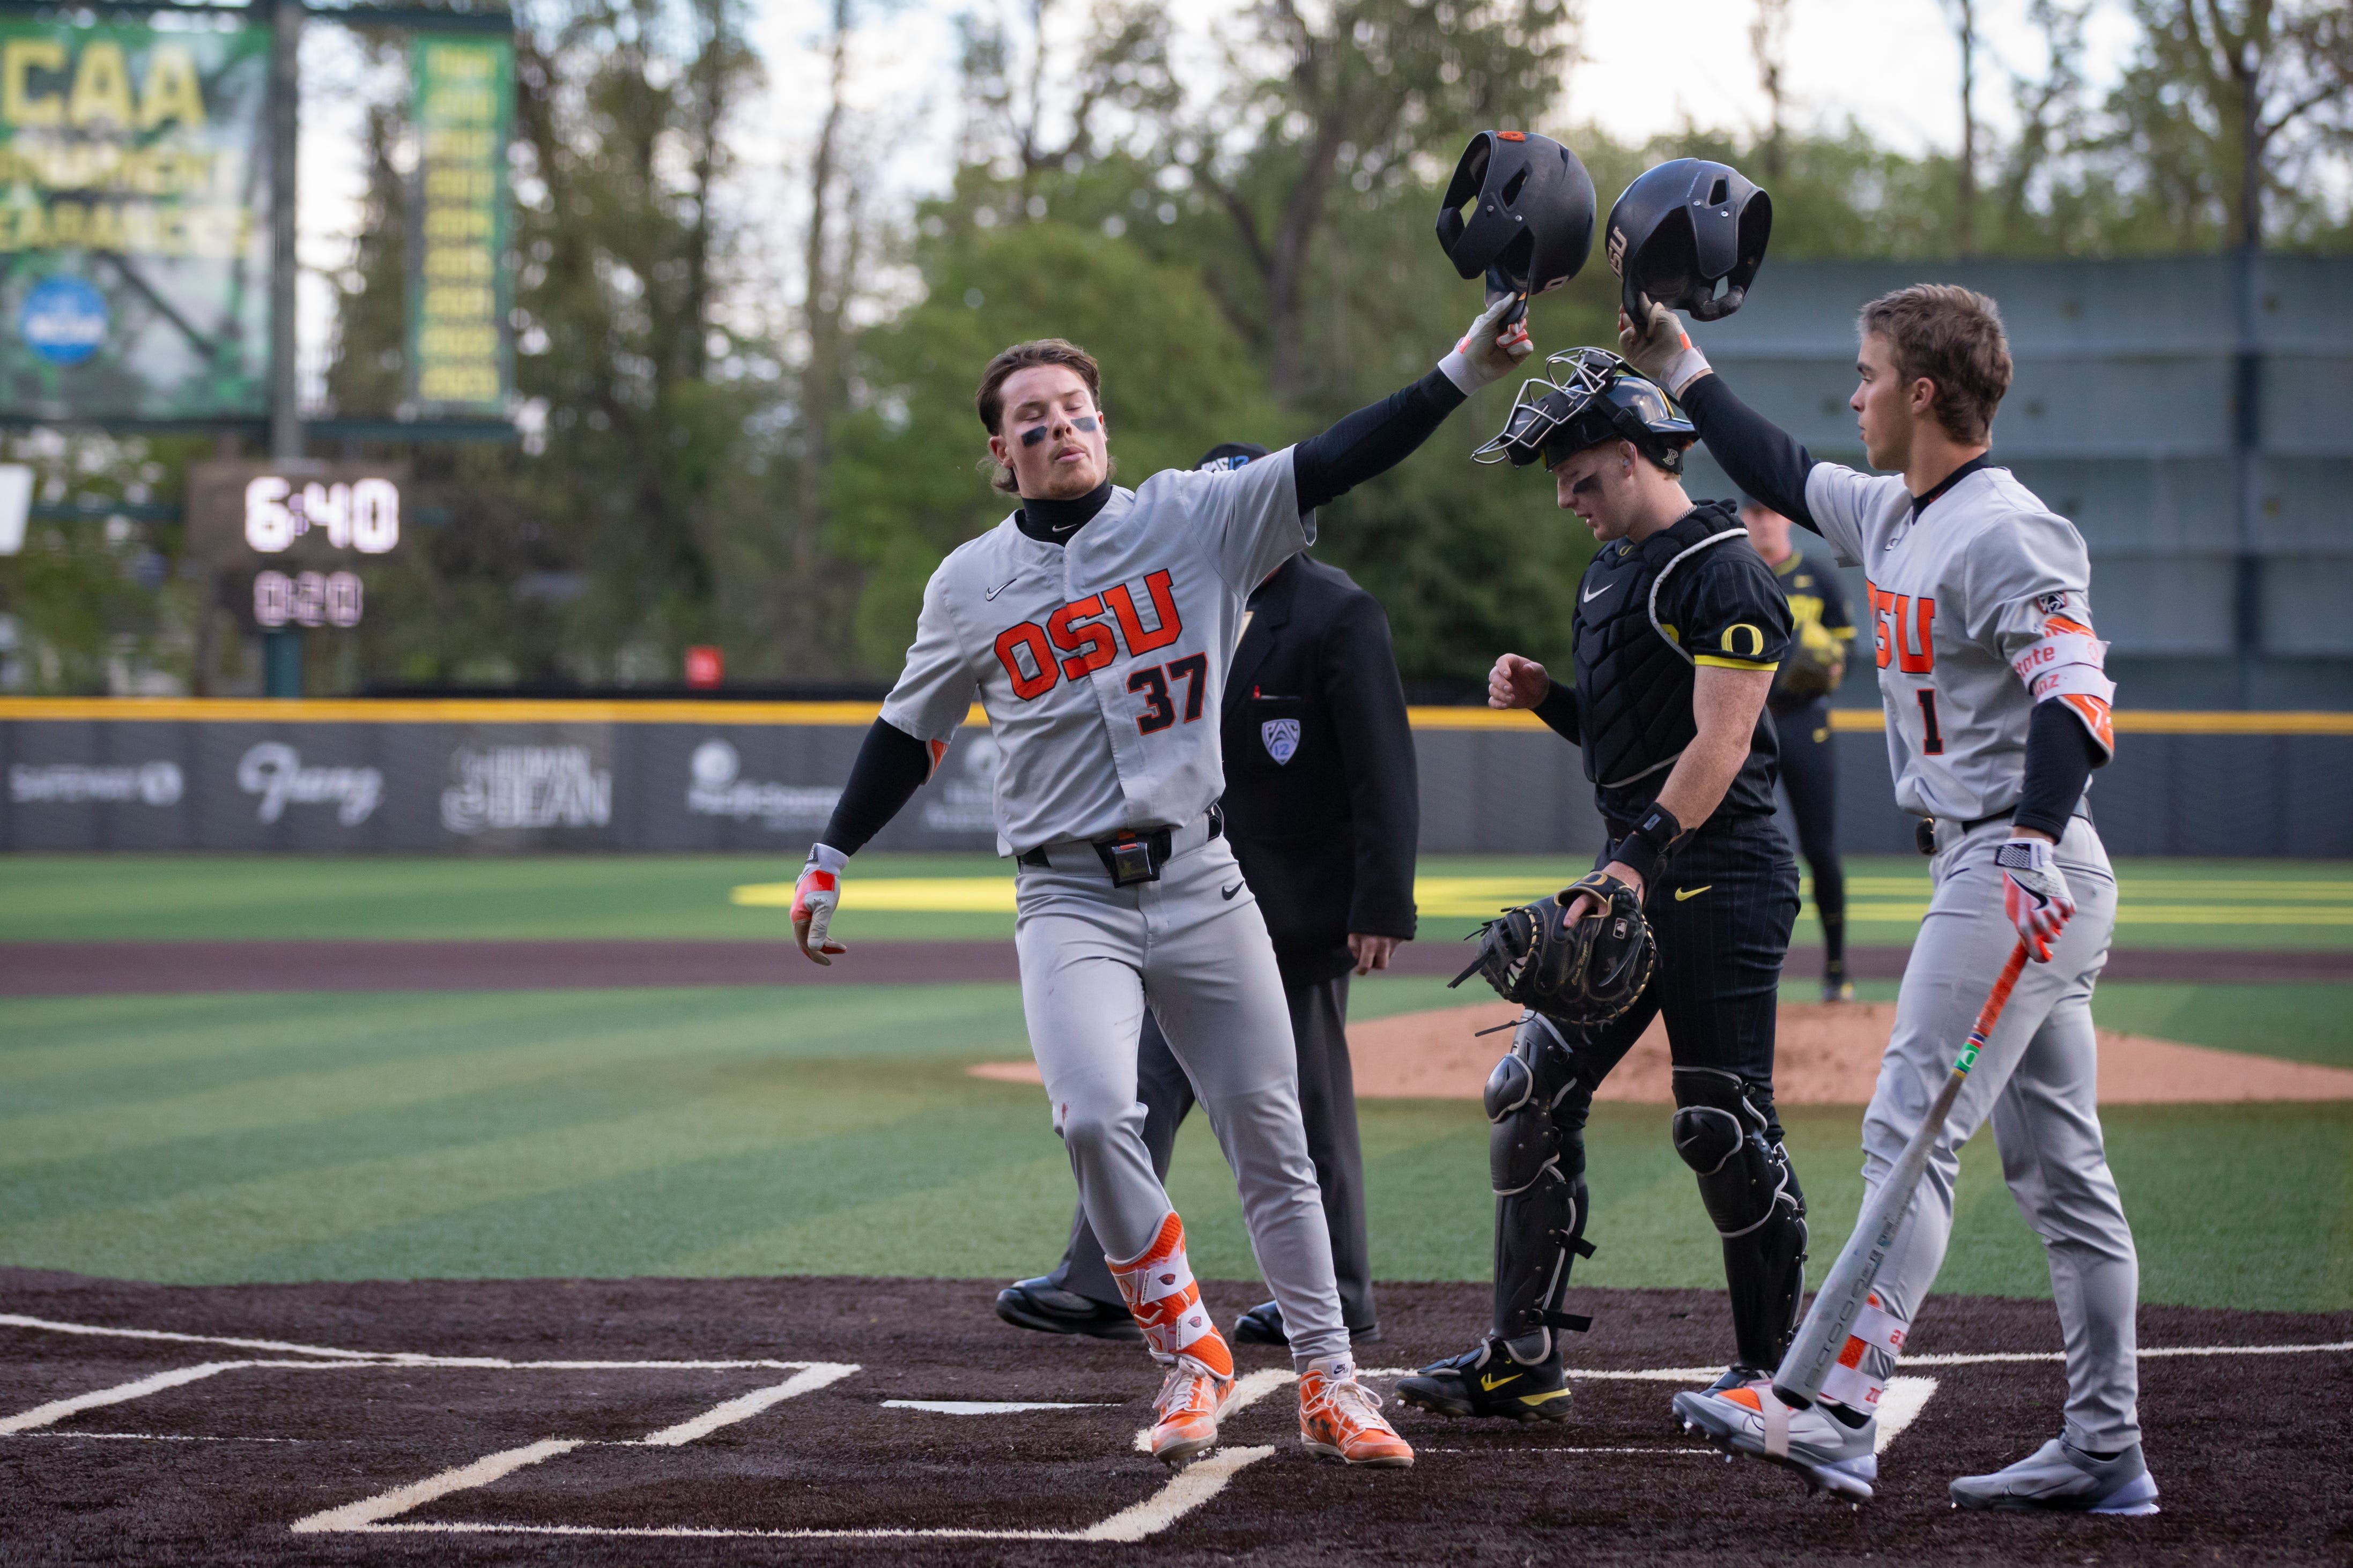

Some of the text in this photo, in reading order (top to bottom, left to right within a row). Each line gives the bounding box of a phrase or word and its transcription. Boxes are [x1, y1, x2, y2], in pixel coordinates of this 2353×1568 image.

[245, 476, 399, 553] 6:40
[253, 570, 364, 627] 0:20
[993, 568, 1183, 702] OSU
[1866, 577, 1936, 675] SU
[1127, 651, 1208, 736] 37
[1917, 688, 1944, 755] 1
[1274, 743, 1290, 756] 12
